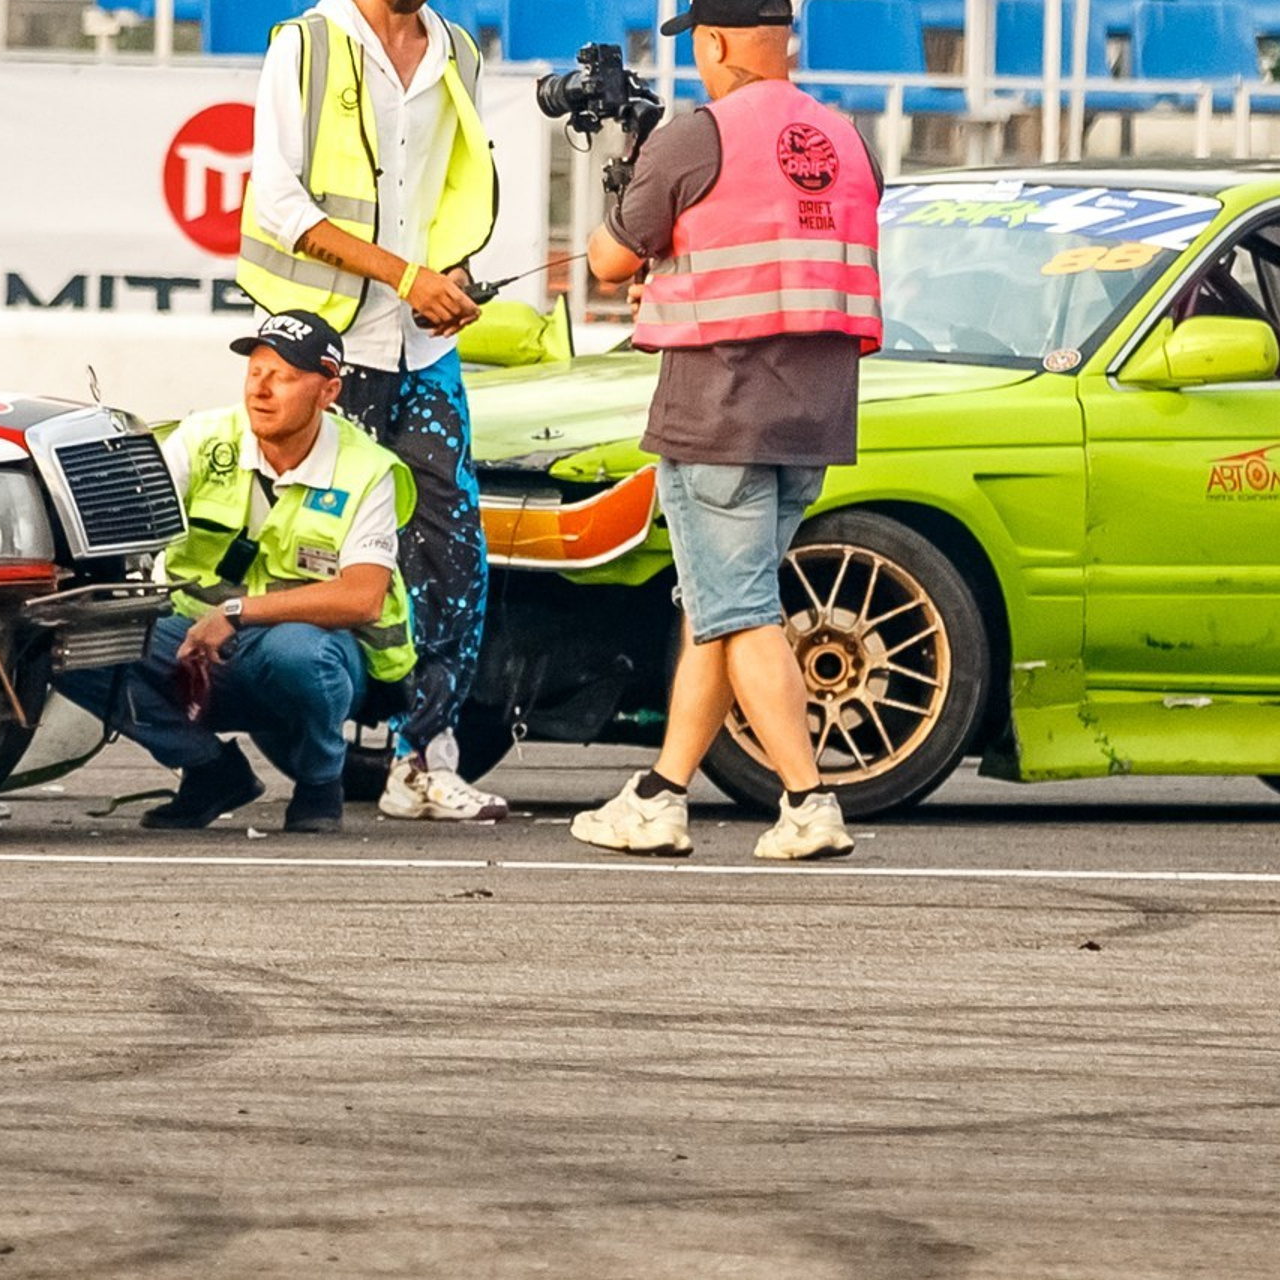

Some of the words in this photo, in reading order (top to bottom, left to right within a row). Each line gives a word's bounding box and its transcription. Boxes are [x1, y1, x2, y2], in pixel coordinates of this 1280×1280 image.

[798, 200, 832, 214] DRIFT
[798, 216, 836, 230] MEDIA
[1040, 241, 1163, 276] 88
